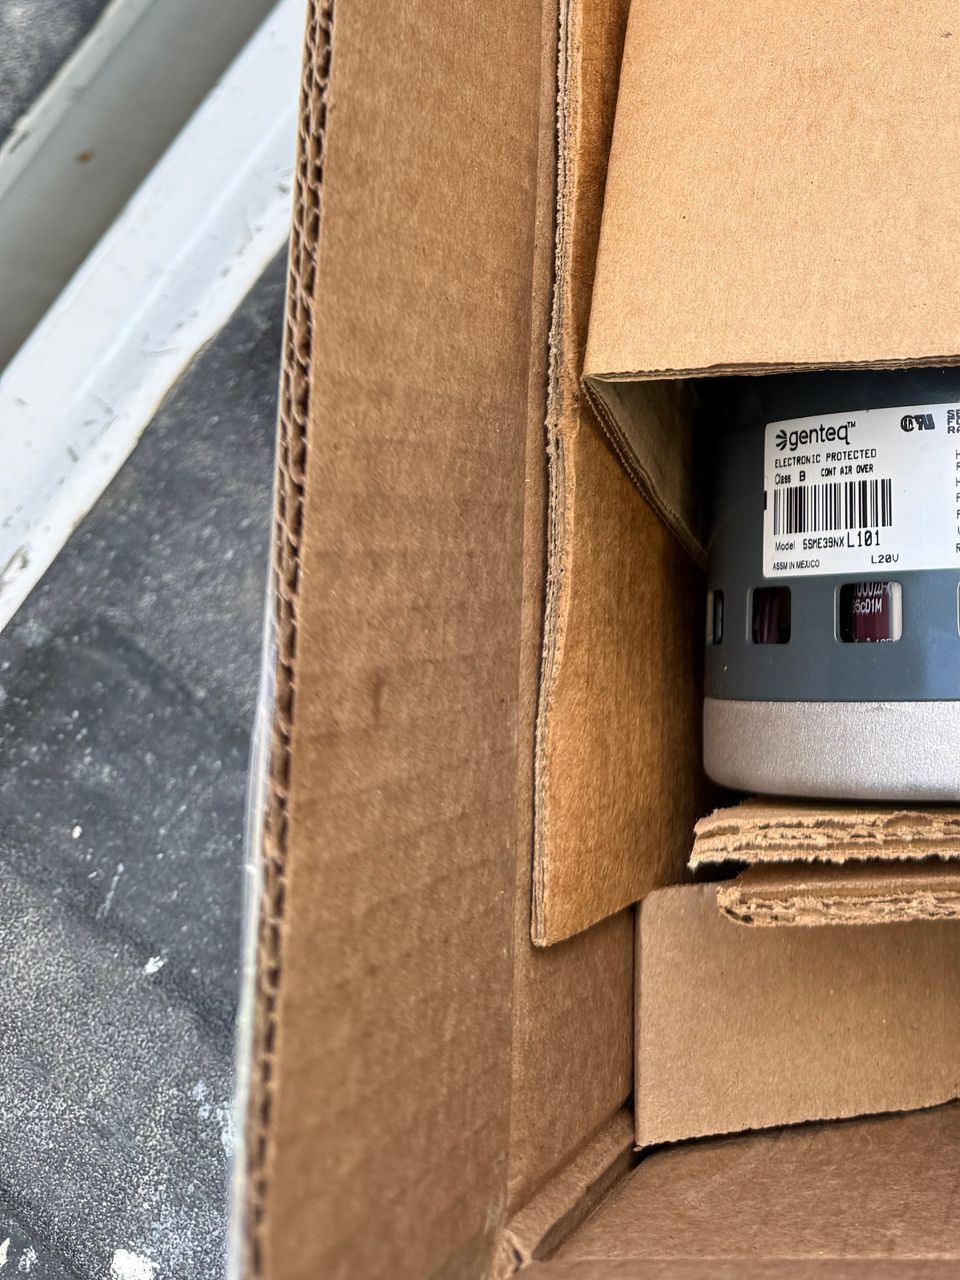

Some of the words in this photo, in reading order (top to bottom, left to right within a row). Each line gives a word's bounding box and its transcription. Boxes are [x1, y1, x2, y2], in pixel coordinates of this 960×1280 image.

[775, 454, 821, 468] ELECTRONIC
[826, 448, 877, 462] PROTECTED
[775, 473, 791, 485] Class
[799, 470, 806, 482] B
[821, 467, 836, 477] CONT
[840, 465, 852, 475] AIR
[856, 463, 873, 475] OVER
[775, 541, 795, 552] Model
[773, 561, 788, 570] ASSM
[789, 561, 795, 570] IN
[796, 559, 820, 569] MEXICO
